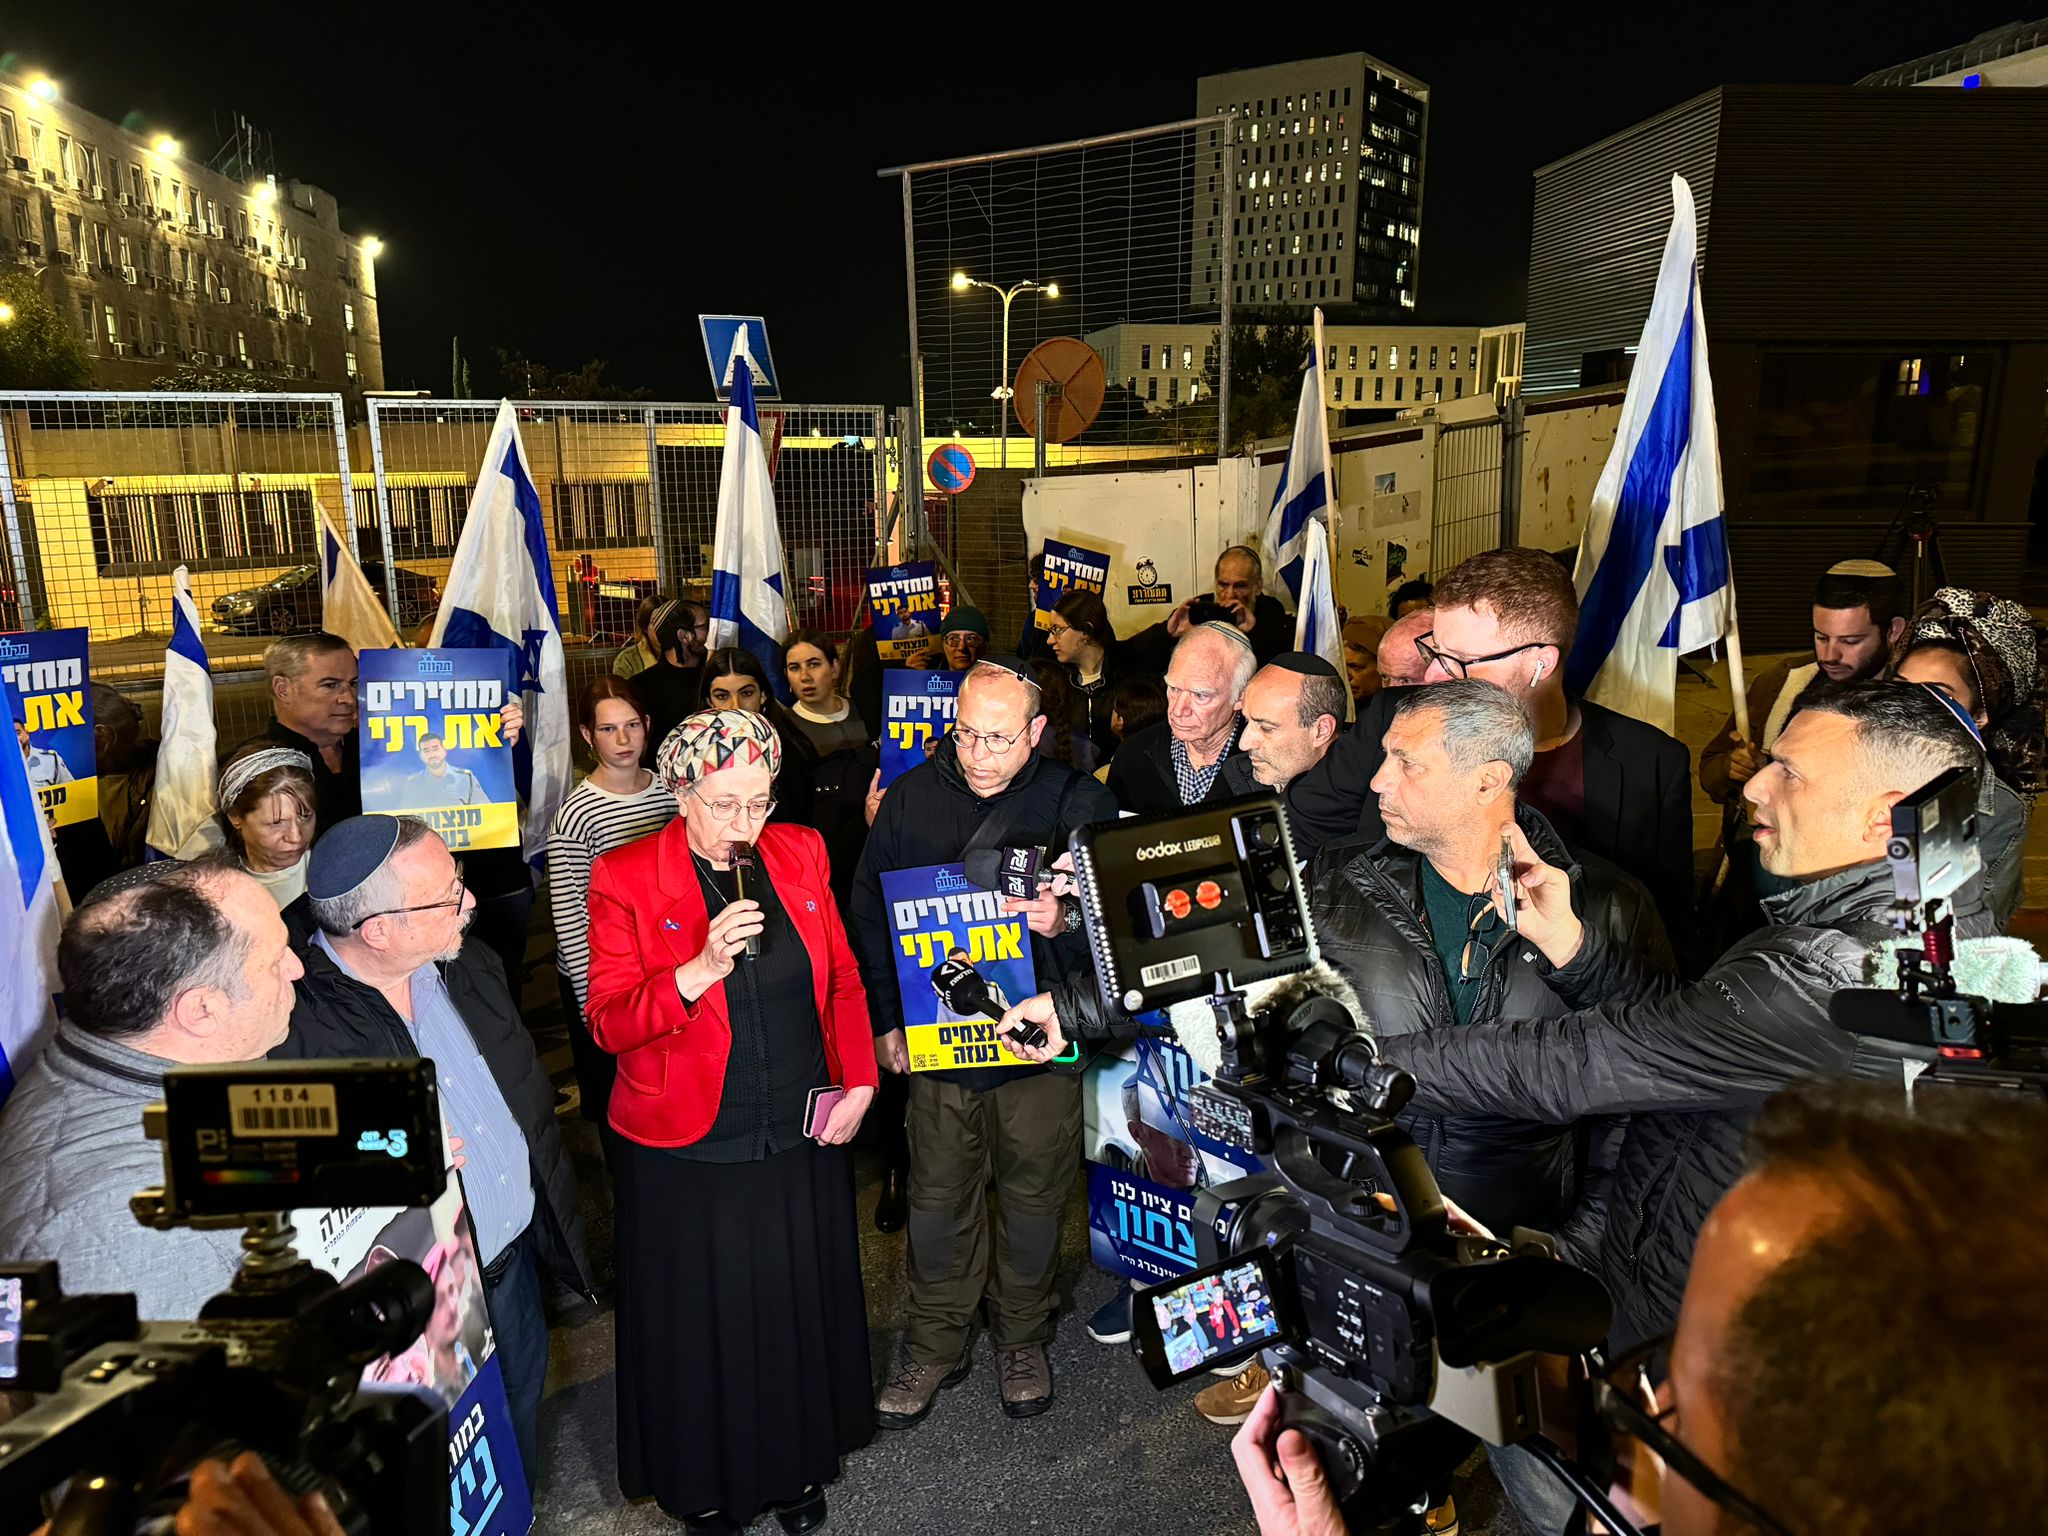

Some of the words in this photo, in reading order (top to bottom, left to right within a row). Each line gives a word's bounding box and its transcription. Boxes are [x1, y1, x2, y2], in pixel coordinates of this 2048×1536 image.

[1044, 554, 1104, 582] מחזירים
[869, 576, 934, 598] מחזירים
[1043, 569, 1069, 591] רני
[872, 598, 901, 616] רני
[907, 592, 936, 613] את
[0, 645, 28, 656] תקוו
[1, 658, 82, 692] מחזי
[418, 660, 453, 673] תקווה
[367, 680, 502, 711] מחזירים
[927, 681, 953, 690] תקווה
[24, 691, 85, 733] את
[888, 695, 959, 719] זירים
[368, 716, 429, 752] רני
[444, 714, 503, 750] את
[888, 721, 933, 750] רני
[425, 808, 482, 829] מנצח
[440, 829, 471, 848] בע
[1136, 841, 1182, 861] Godox
[900, 931, 955, 968] רני
[968, 922, 1024, 962] את
[949, 968, 975, 987] חדשות
[938, 1023, 1002, 1045] נצחים
[953, 1043, 1000, 1064] בעזה
[253, 1087, 309, 1103] 1184
[1111, 1180, 1136, 1200] לנו
[1141, 1190, 1172, 1215] ציוו
[1110, 1199, 1197, 1259] צחון.
[449, 1403, 485, 1474] במות
